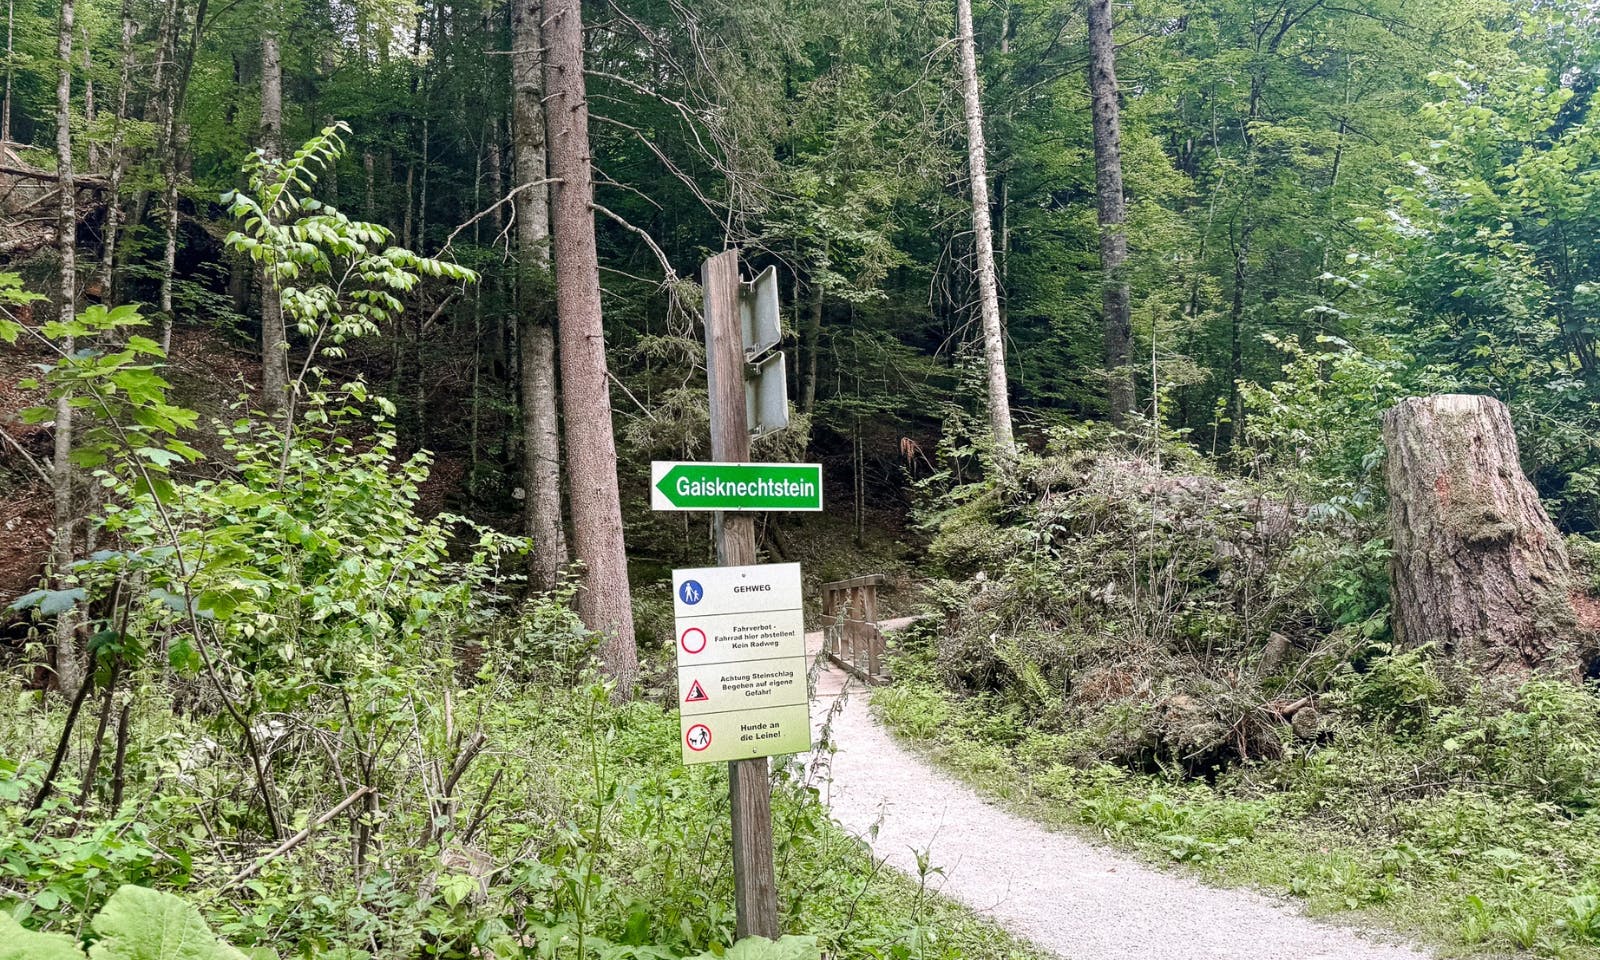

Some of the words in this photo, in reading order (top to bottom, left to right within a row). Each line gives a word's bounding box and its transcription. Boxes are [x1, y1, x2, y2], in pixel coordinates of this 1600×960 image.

[676, 476, 814, 497] Gaisknechtstein
[733, 584, 771, 593] GEHWEG
[733, 624, 772, 633] Fahrverbot
[715, 632, 743, 642] Fahrrad
[744, 631, 758, 640] hier
[760, 630, 795, 639] abstellen!
[732, 641, 749, 649] Kein
[750, 640, 779, 648] Radweg
[720, 674, 751, 683] Achtung
[752, 671, 794, 680] Steinschlag
[722, 682, 754, 691] Begehen
[769, 679, 793, 687] eigene
[745, 688, 772, 697] Gefahr!
[740, 723, 767, 732] Hunde
[740, 733, 753, 741] die
[755, 731, 781, 740] Leine!
